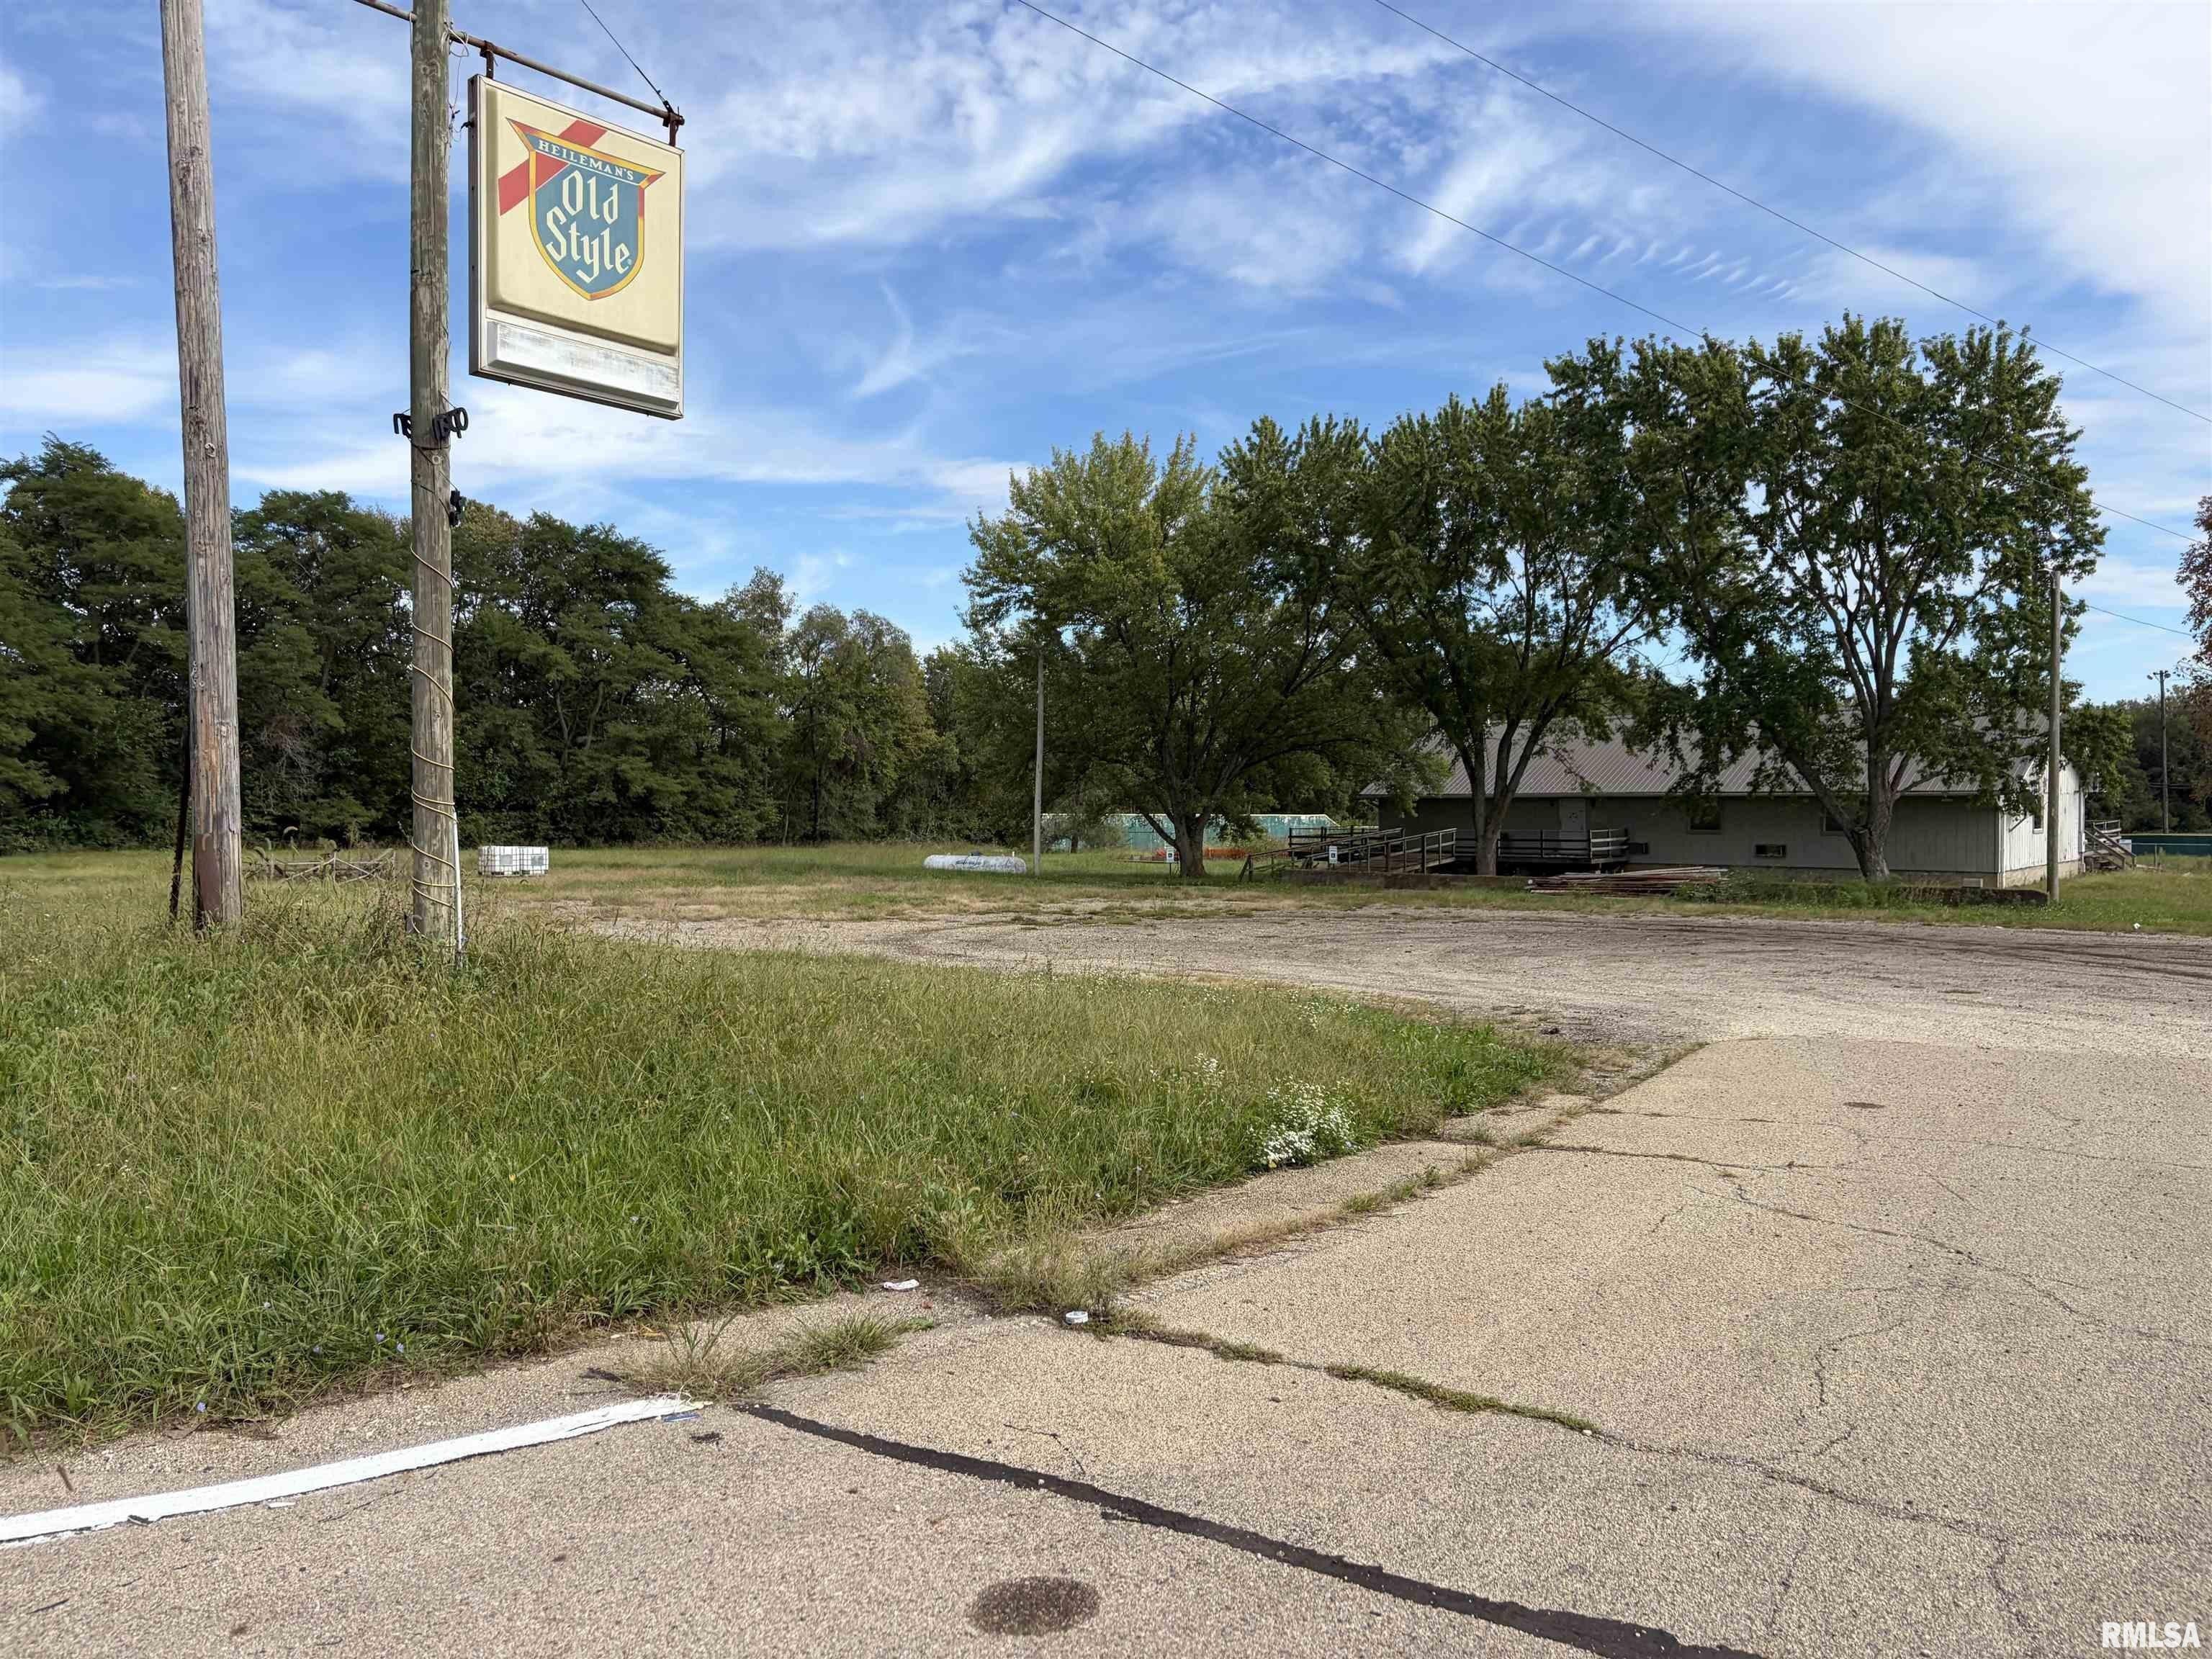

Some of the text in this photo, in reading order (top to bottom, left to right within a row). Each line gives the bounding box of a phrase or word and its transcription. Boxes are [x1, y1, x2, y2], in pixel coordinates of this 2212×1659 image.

[538, 140, 634, 181] HEILEMAN'S
[562, 170, 619, 225] Old
[546, 206, 630, 283] Style
